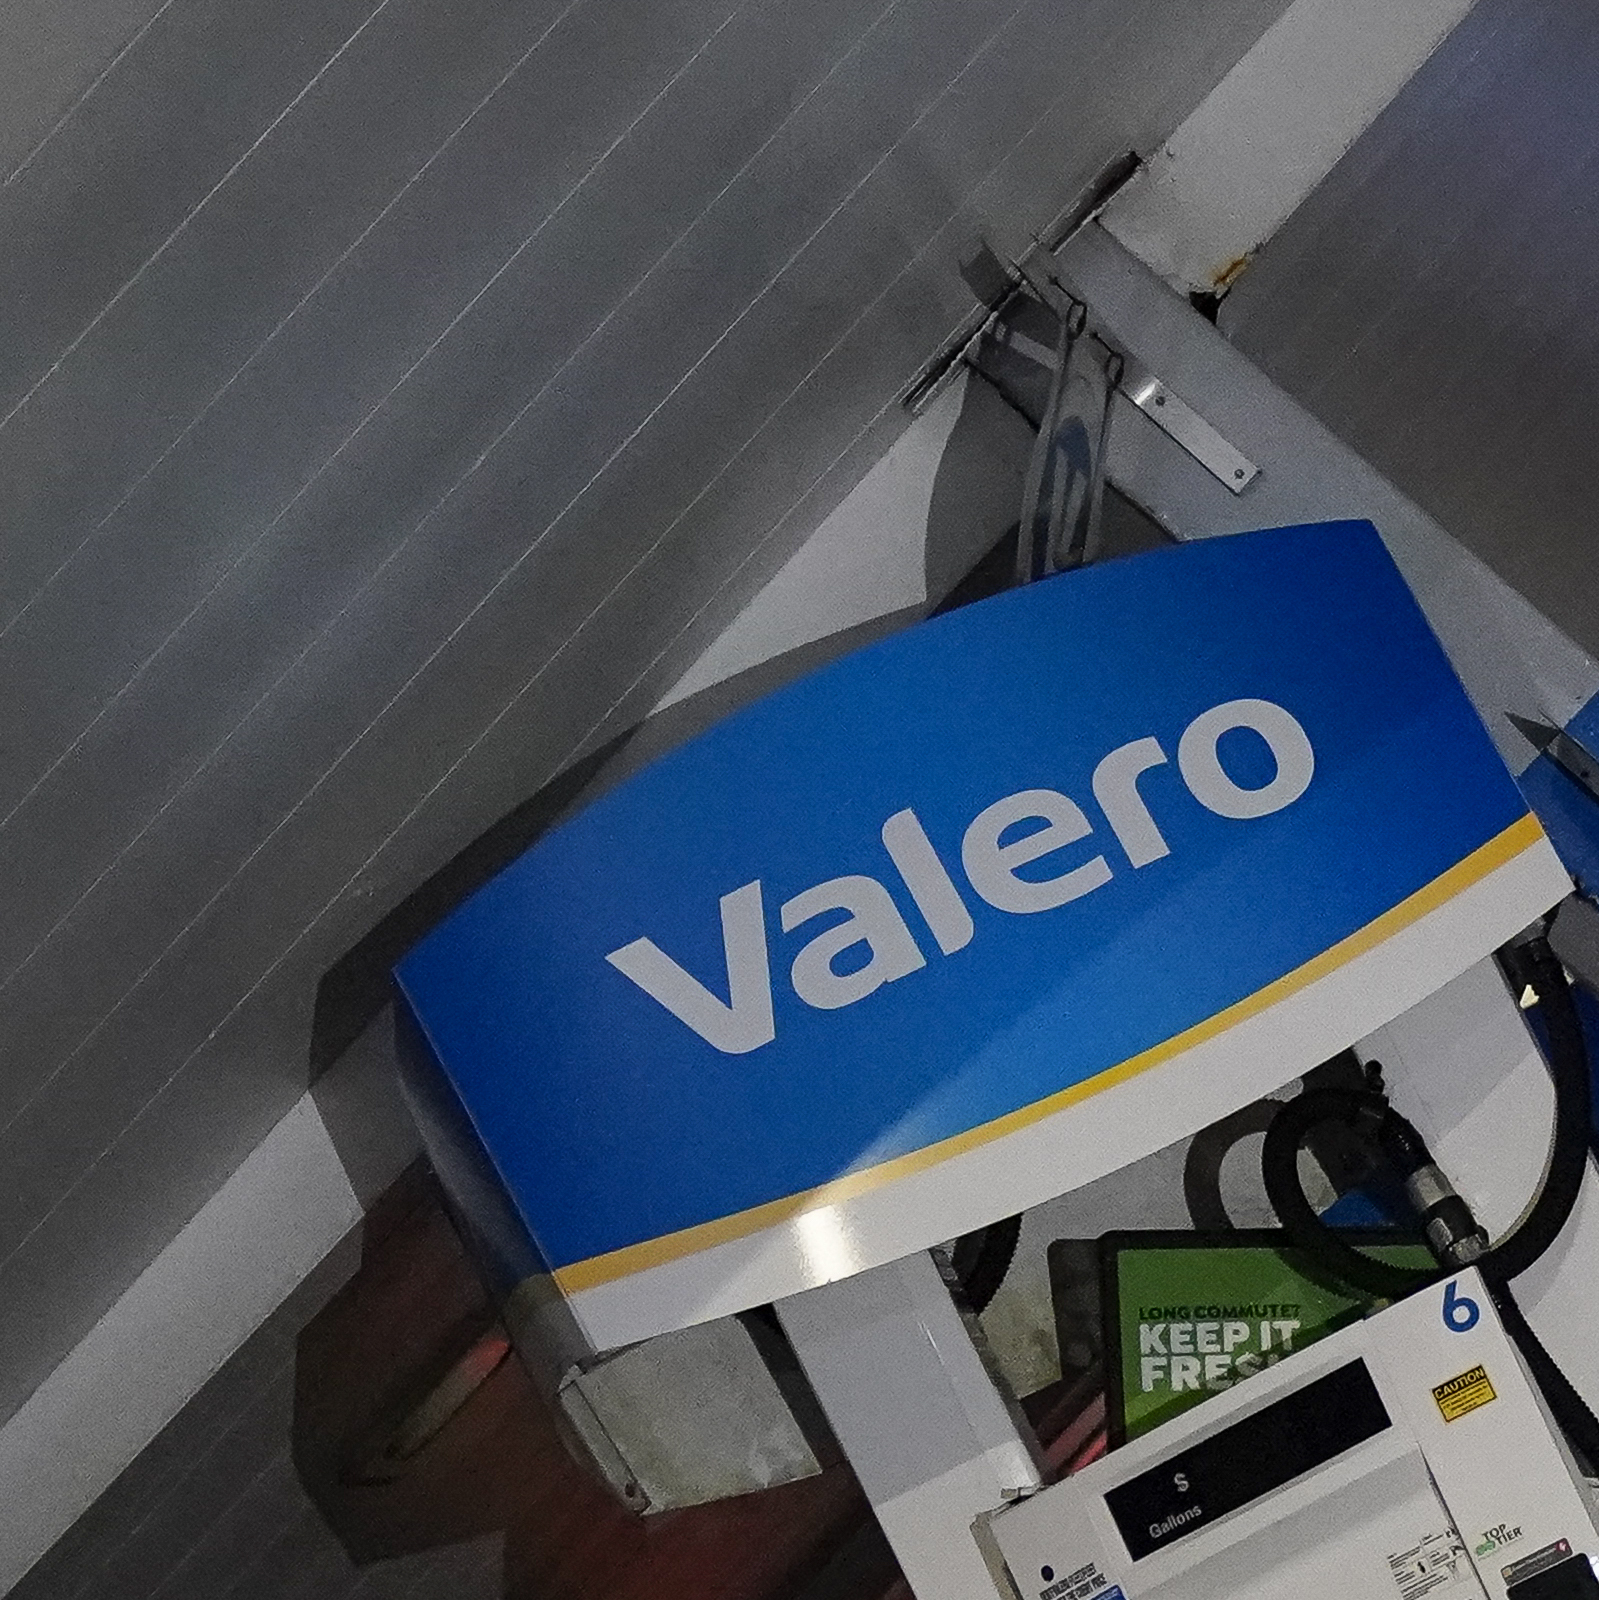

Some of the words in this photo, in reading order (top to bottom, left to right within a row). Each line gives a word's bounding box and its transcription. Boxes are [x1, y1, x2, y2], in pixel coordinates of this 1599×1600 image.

[604, 697, 1316, 1055] Valero
[1139, 1306, 1190, 1320] LONG
[1194, 1304, 1300, 1319] COMMUTE?
[1442, 1281, 1480, 1332] 6
[1139, 1321, 1250, 1354] KEEP
[1260, 1319, 1301, 1350] IT
[1140, 1352, 1280, 1393] FRES
[1434, 1368, 1485, 1399] CAUTION
[1173, 1473, 1189, 1493] $
[1149, 1503, 1202, 1540] Gallons
[1481, 1523, 1506, 1542] TOP
[1496, 1526, 1523, 1546] TIER
